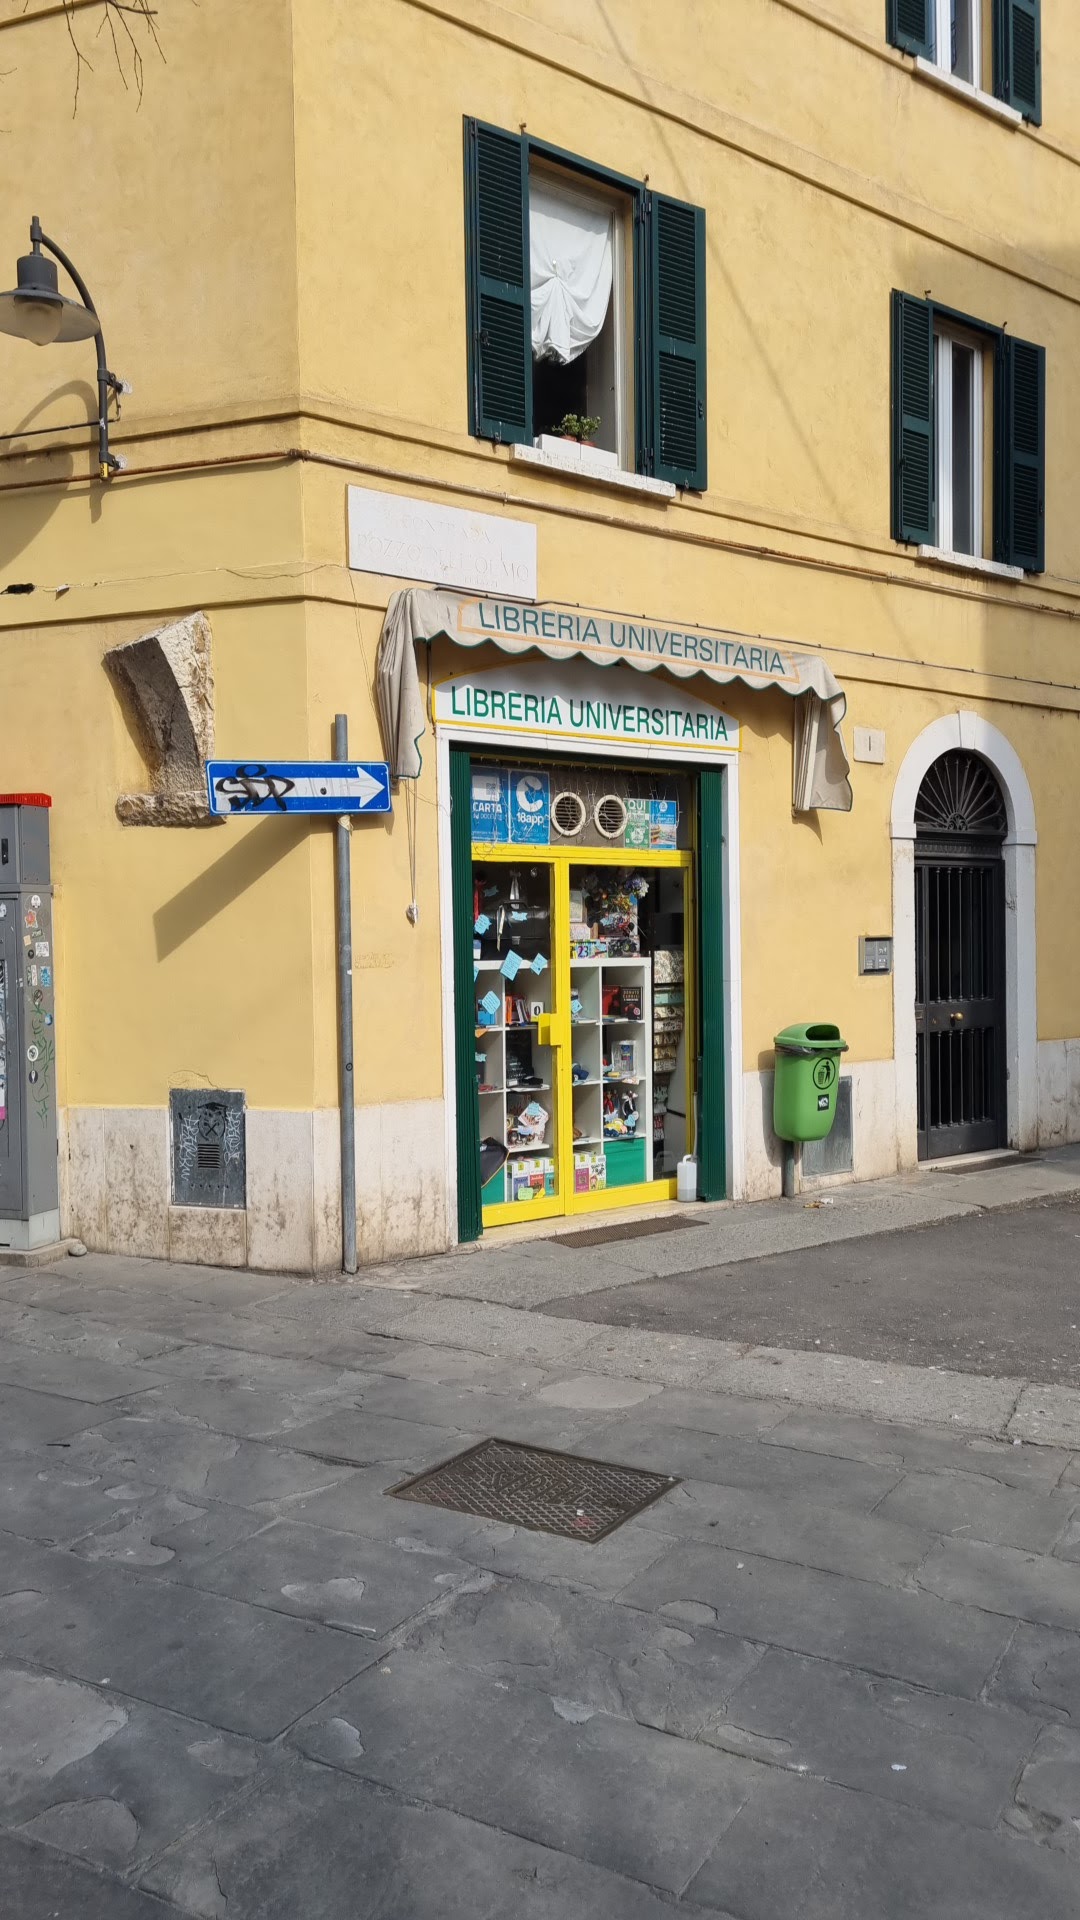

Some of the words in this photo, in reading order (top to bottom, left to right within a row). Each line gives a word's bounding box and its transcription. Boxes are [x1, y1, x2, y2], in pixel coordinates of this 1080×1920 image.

[477, 602, 601, 645] LIBRERIA
[609, 622, 786, 675] UNIVERSITARIA
[451, 685, 563, 726] LIBRERIA
[569, 699, 728, 741] UNIVERSITARIA
[472, 801, 503, 814] CARTA
[516, 812, 544, 827] 18app
